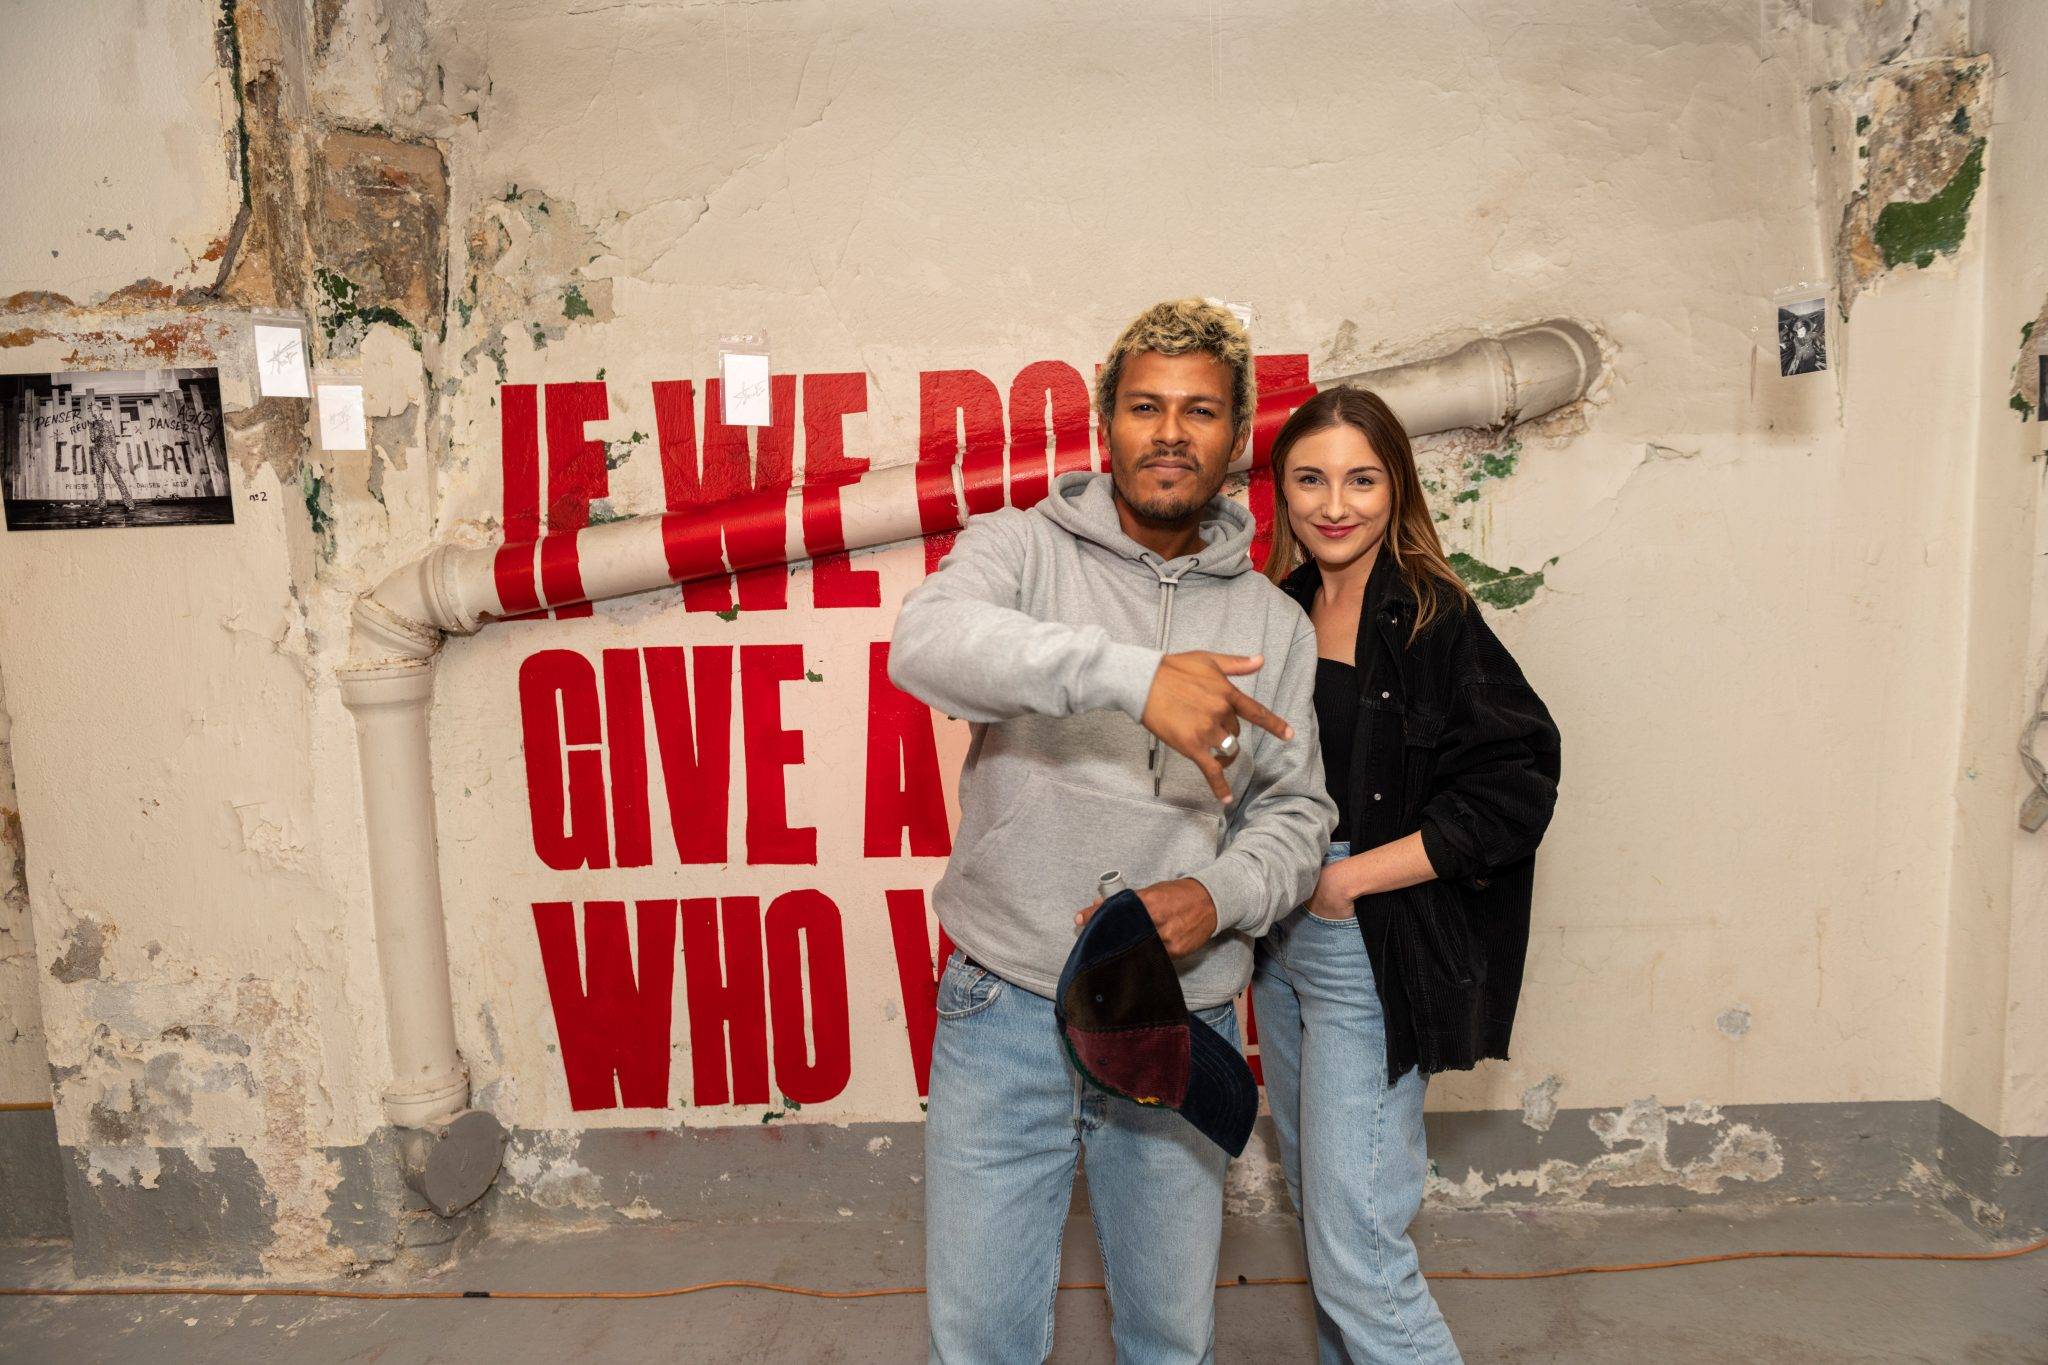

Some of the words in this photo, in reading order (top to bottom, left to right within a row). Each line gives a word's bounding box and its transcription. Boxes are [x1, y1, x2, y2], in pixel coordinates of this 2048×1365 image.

[34, 410, 82, 431] PENSER
[55, 440, 192, 475] COULAT
[148, 417, 194, 433] DANSER
[495, 381, 609, 622] IF
[651, 372, 882, 613] WE
[519, 644, 817, 871] GIVE
[531, 888, 851, 1112] WHO
